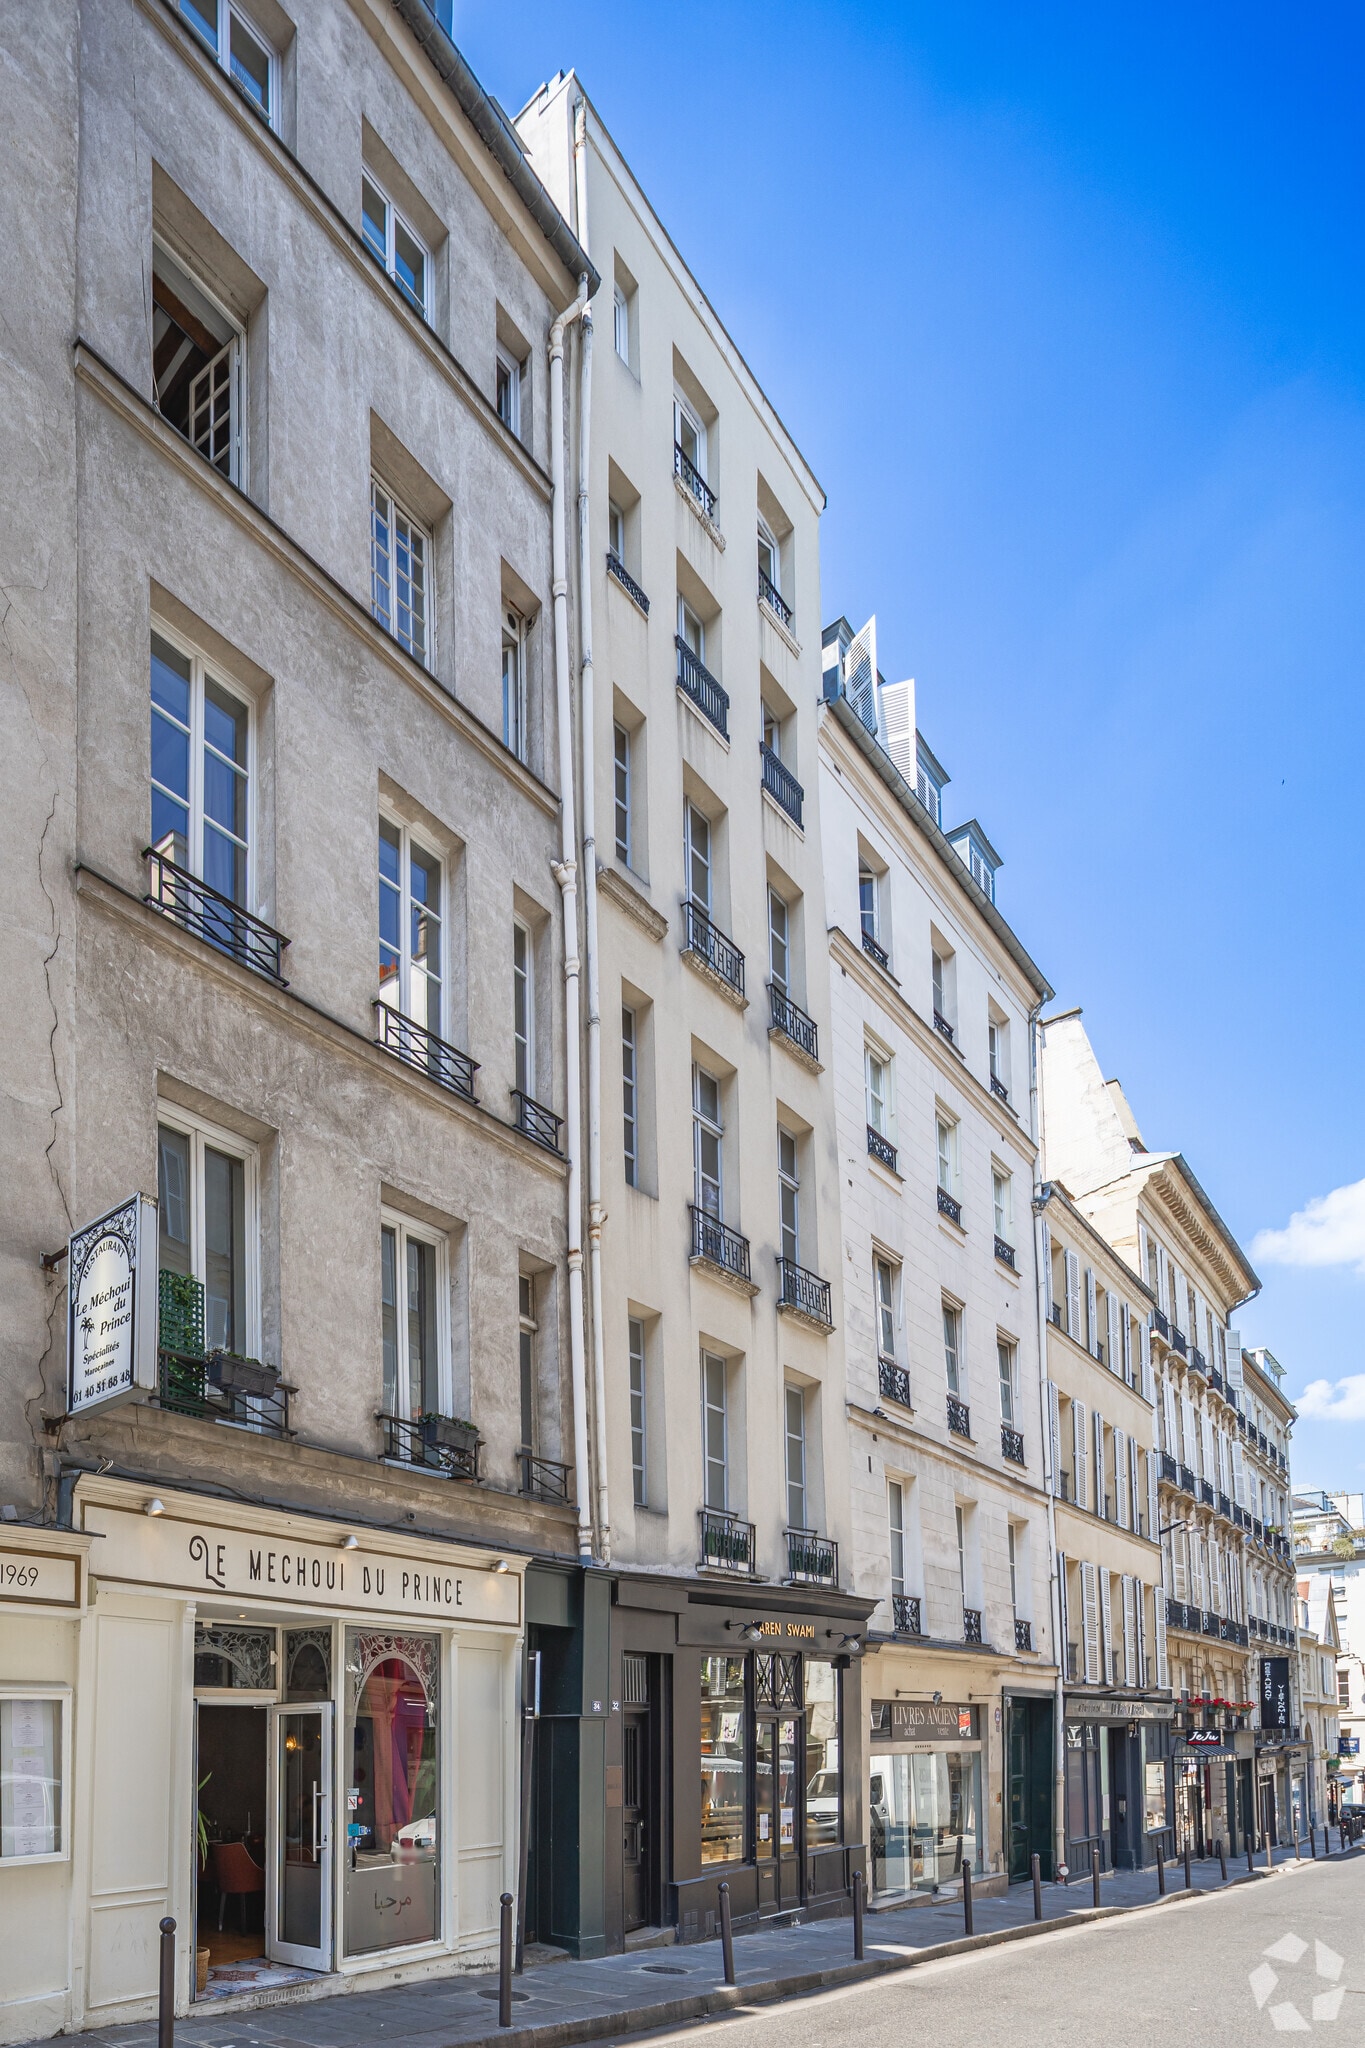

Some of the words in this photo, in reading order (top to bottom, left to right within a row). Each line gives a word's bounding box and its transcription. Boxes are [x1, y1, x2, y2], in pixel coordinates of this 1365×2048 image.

[83, 1240, 125, 1279] RESTAURANT
[76, 1303, 88, 1317] Le
[90, 1276, 131, 1310] Méchoui
[113, 1297, 126, 1312] du
[100, 1312, 131, 1335] Prince
[83, 1341, 120, 1365] Spécialités
[73, 1390, 82, 1404] 01
[0, 1563, 39, 1587] 1969
[189, 1535, 226, 1589] LE
[249, 1550, 344, 1591] MECHOUI
[363, 1566, 385, 1596] DU
[402, 1572, 463, 1606] PRINCE
[752, 1620, 782, 1636] AREN
[787, 1623, 815, 1638] SWAMI
[1264, 1661, 1272, 1701] RESTAURANT
[612, 1701, 620, 1711] 32
[894, 1706, 925, 1725] LIVRES
[926, 1707, 958, 1725] ANCIENS
[1277, 1684, 1286, 1725] VIETNAMIEN
[904, 1725, 916, 1736] achat
[937, 1727, 949, 1736] vente
[1188, 1731, 1219, 1741] JeJu
[374, 1890, 412, 1916] مرحبا
